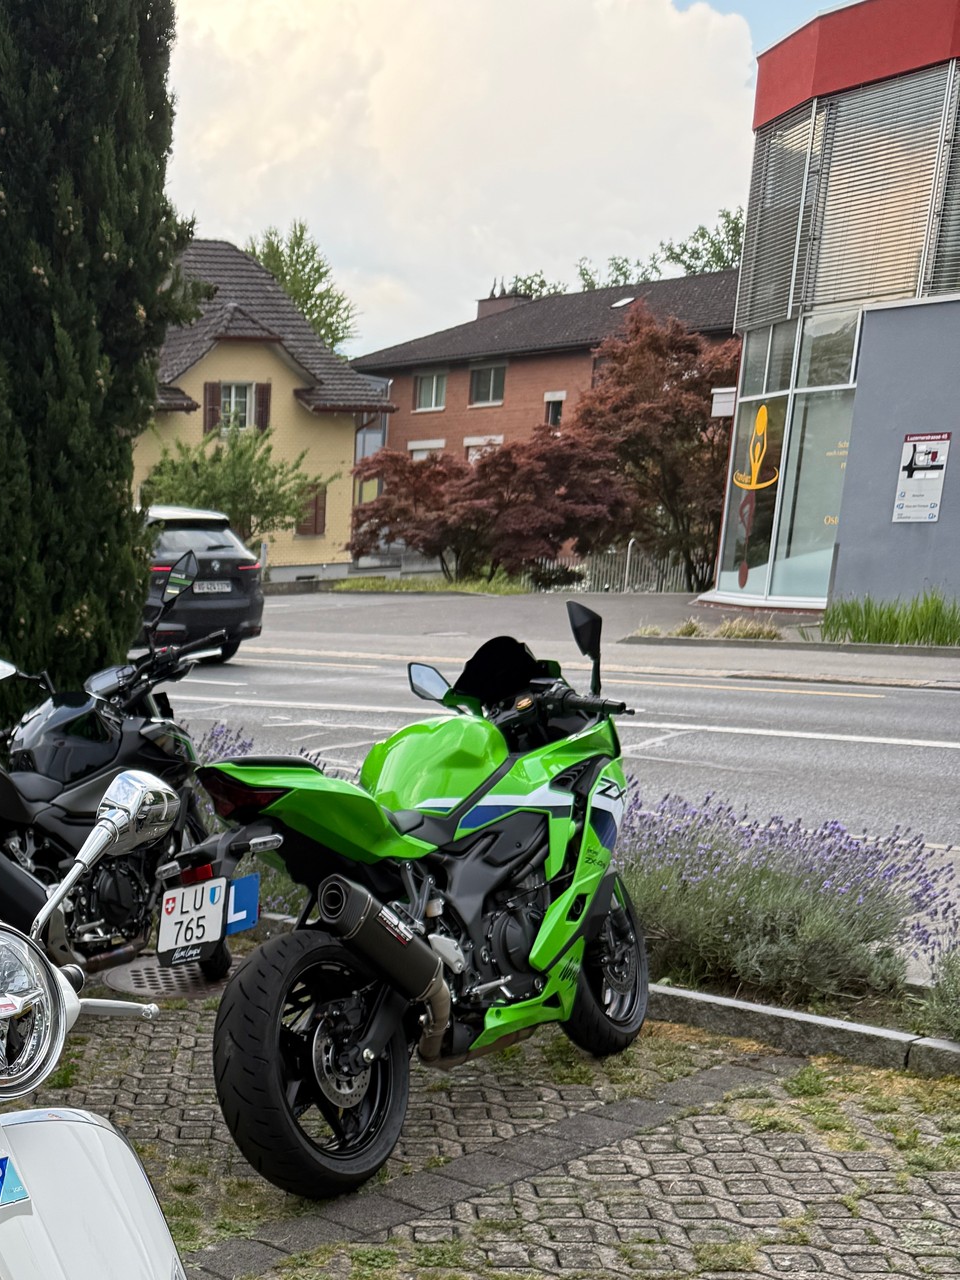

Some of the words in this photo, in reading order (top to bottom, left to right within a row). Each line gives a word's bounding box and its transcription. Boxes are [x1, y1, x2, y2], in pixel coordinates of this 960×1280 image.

[180, 886, 205, 915] LU
[227, 885, 247, 924] L
[174, 915, 206, 945] 765
